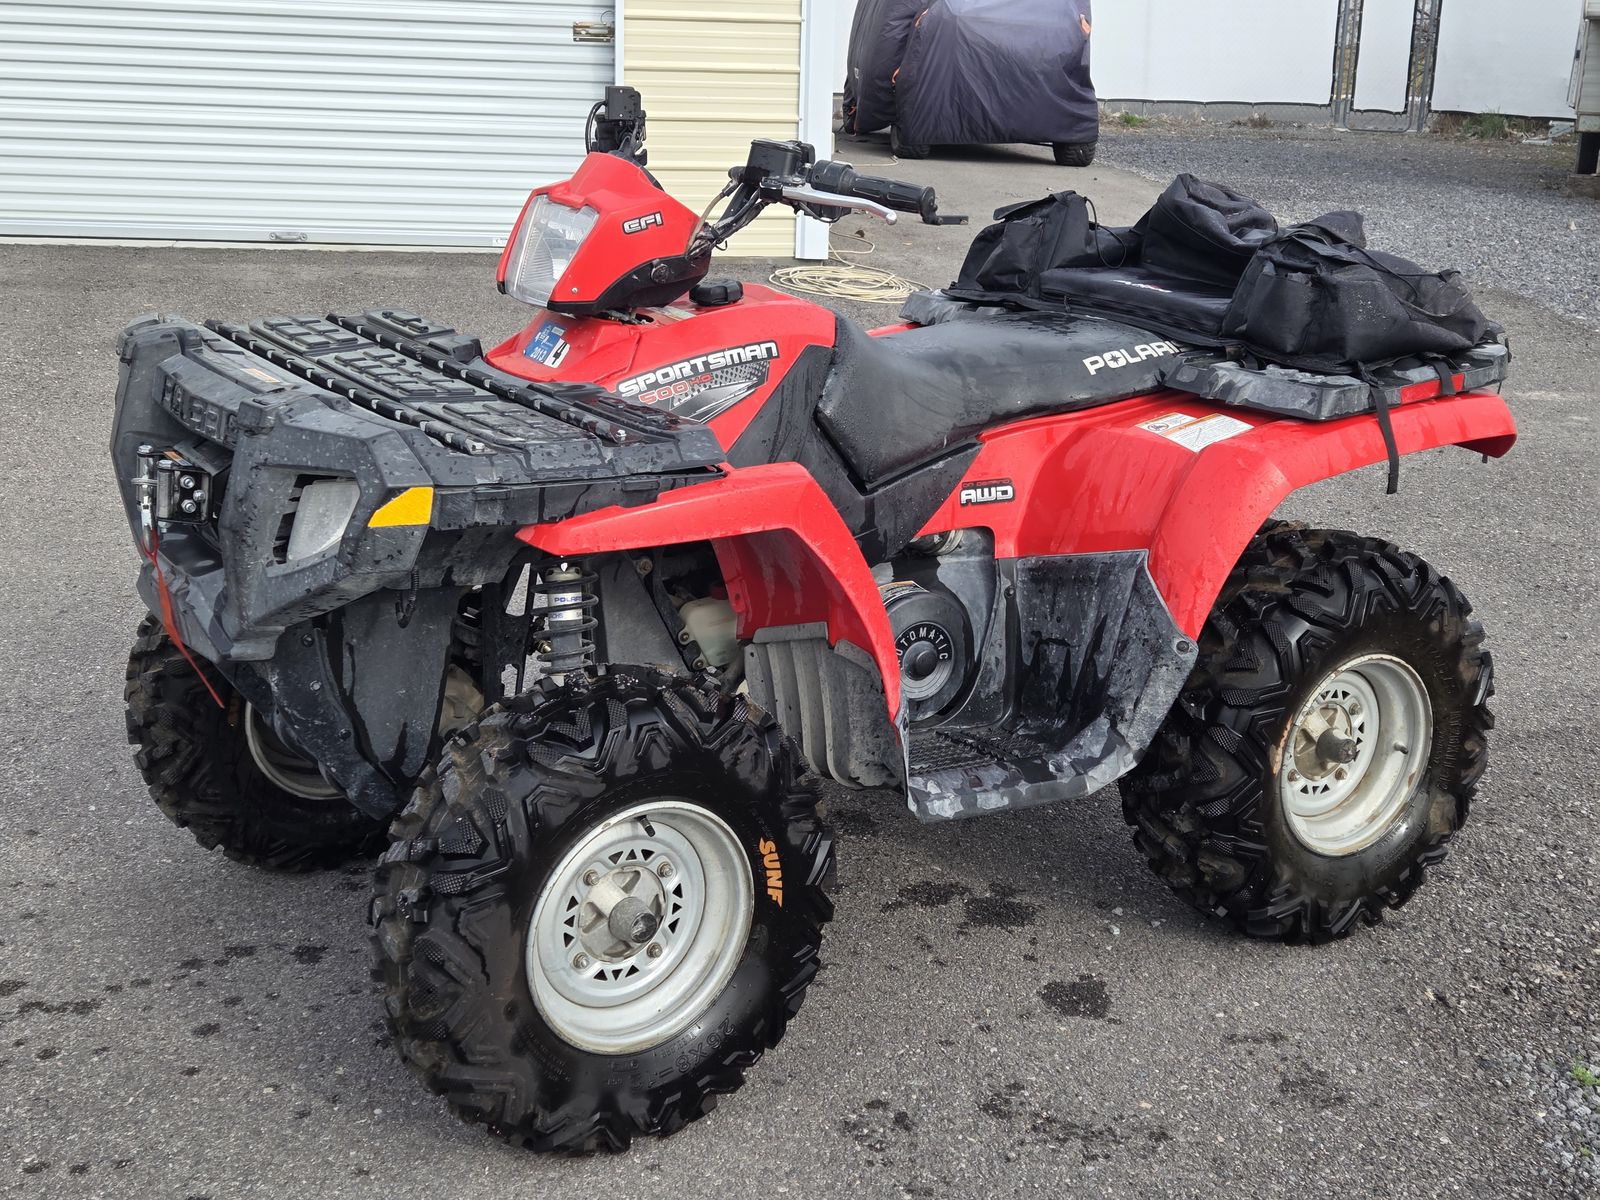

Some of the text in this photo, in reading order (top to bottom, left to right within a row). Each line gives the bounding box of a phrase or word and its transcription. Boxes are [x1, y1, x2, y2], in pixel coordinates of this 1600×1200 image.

[623, 212, 663, 234] EFI
[617, 341, 779, 398] SPORTSMAN
[638, 380, 689, 405] 500
[960, 485, 1014, 504] AWD
[895, 626, 949, 669] UTOMATIC
[759, 837, 783, 908] SUNF
